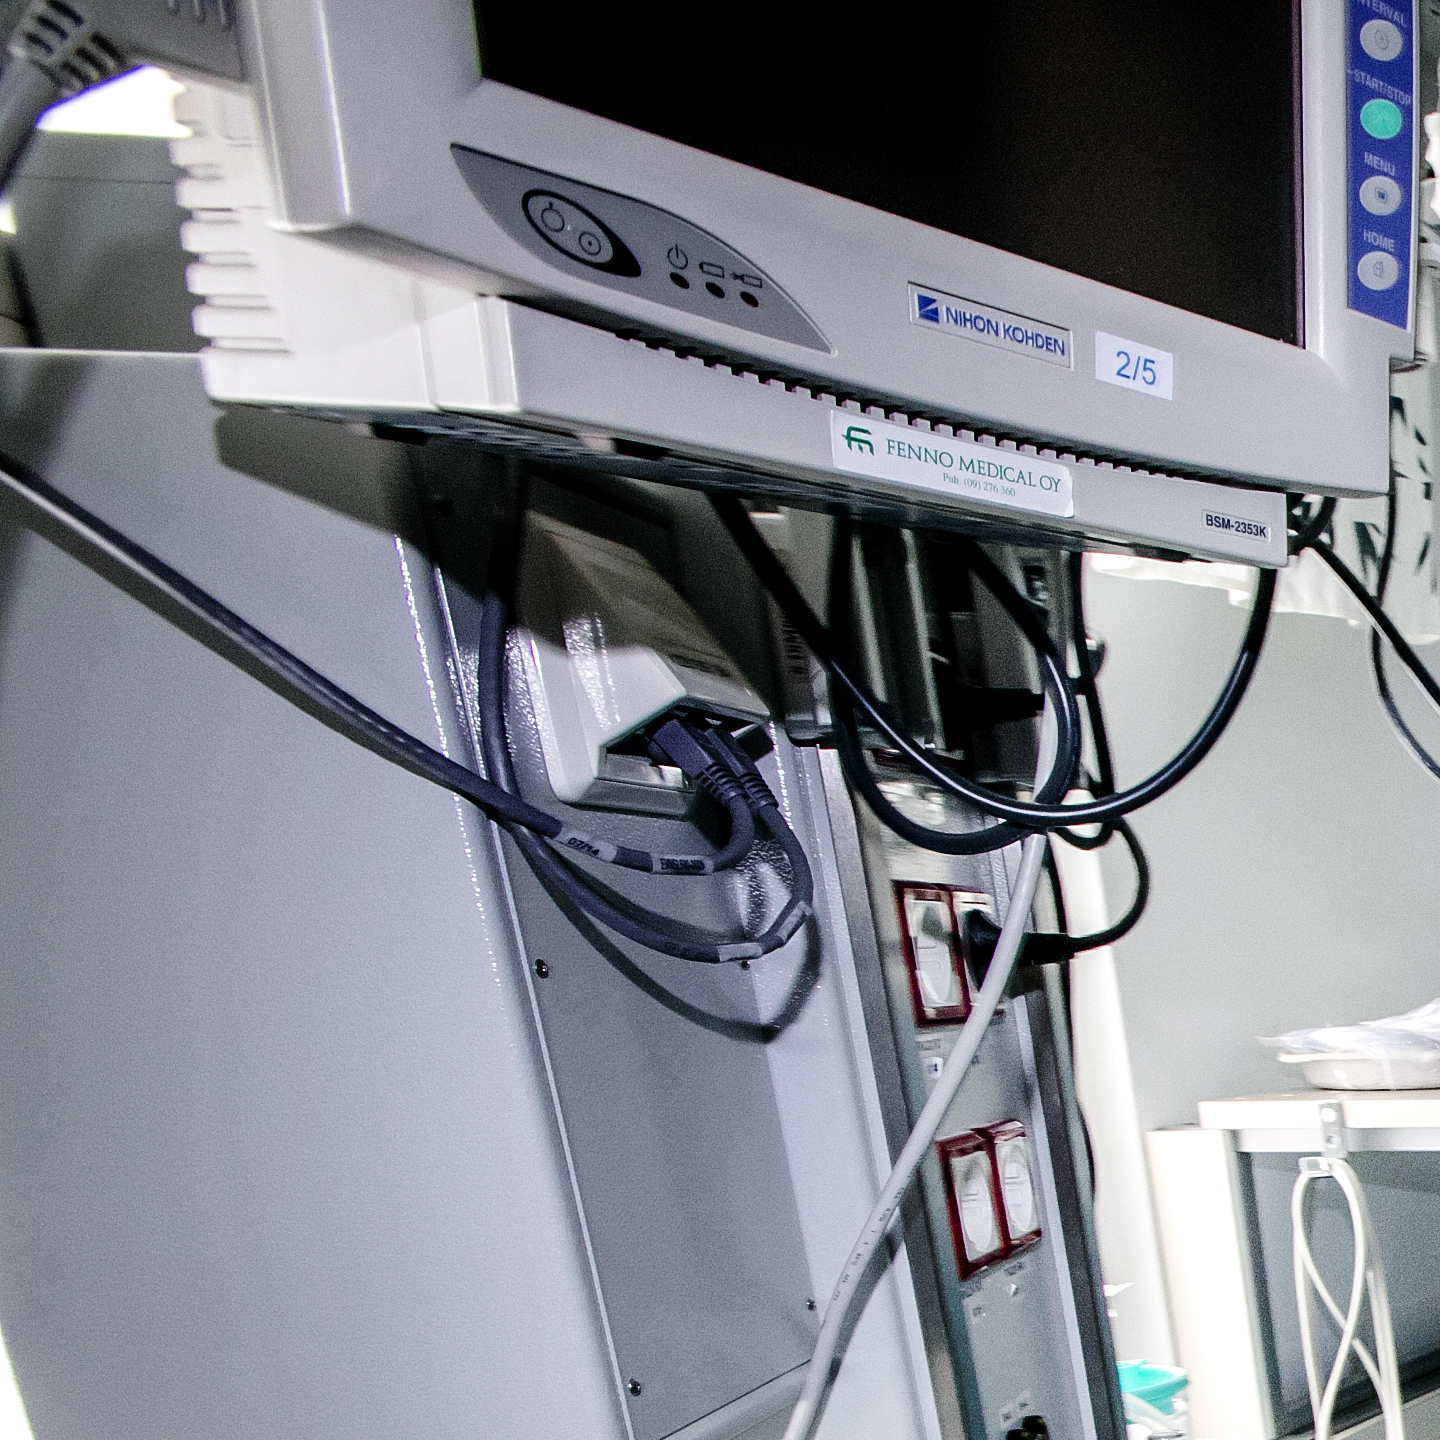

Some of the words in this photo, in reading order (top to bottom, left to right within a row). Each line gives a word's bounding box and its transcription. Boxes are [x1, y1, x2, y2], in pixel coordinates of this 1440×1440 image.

[1354, 69, 1411, 105] START/STOP
[1364, 151, 1395, 176] MENU
[1363, 229, 1394, 252] HOME
[945, 306, 999, 337] NIHON
[1002, 323, 1065, 355] KOHDEN
[1116, 350, 1156, 386] 2/5
[886, 438, 954, 468] FENNO
[959, 456, 1036, 487] MEDICAL
[1039, 476, 1061, 493] OY
[943, 473, 961, 485] Puh.
[963, 477, 981, 490] (09)
[983, 482, 998, 493] 276
[1000, 486, 1015, 497] 360
[1206, 514, 1266, 538] BSM-2353K
